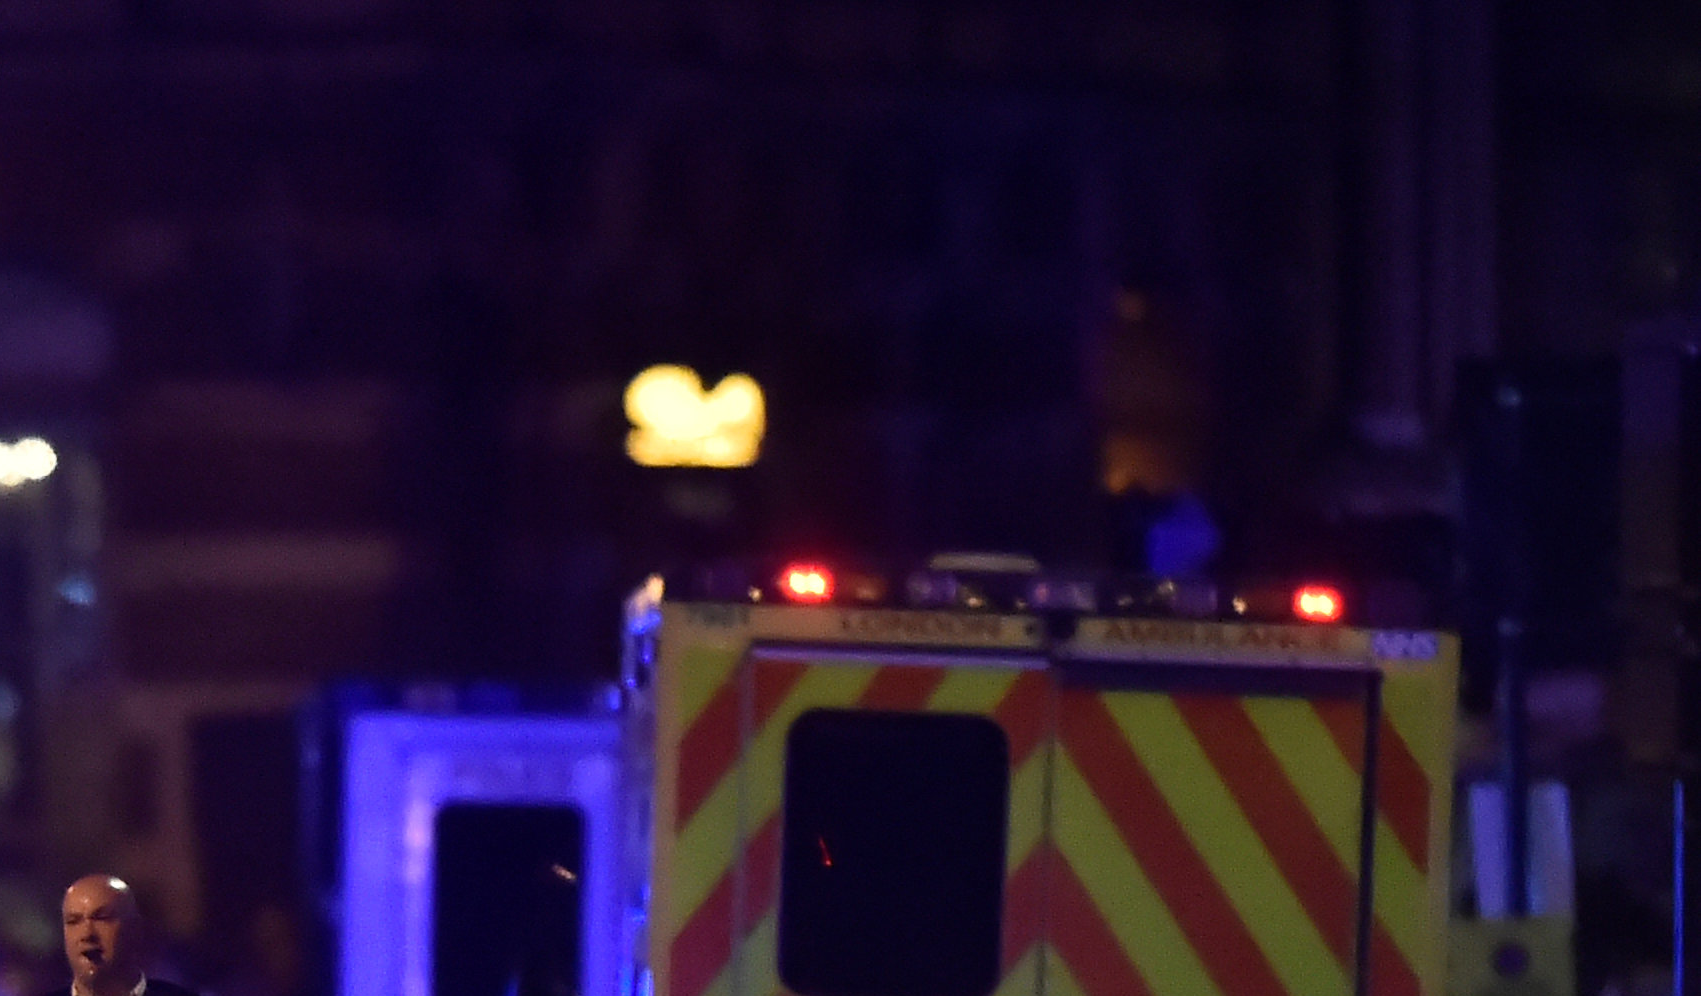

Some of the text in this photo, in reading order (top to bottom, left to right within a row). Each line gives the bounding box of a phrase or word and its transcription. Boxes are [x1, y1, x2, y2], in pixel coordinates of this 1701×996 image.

[839, 615, 1339, 650] LONDON AMBULANCE
[1371, 631, 1437, 659] NHS
